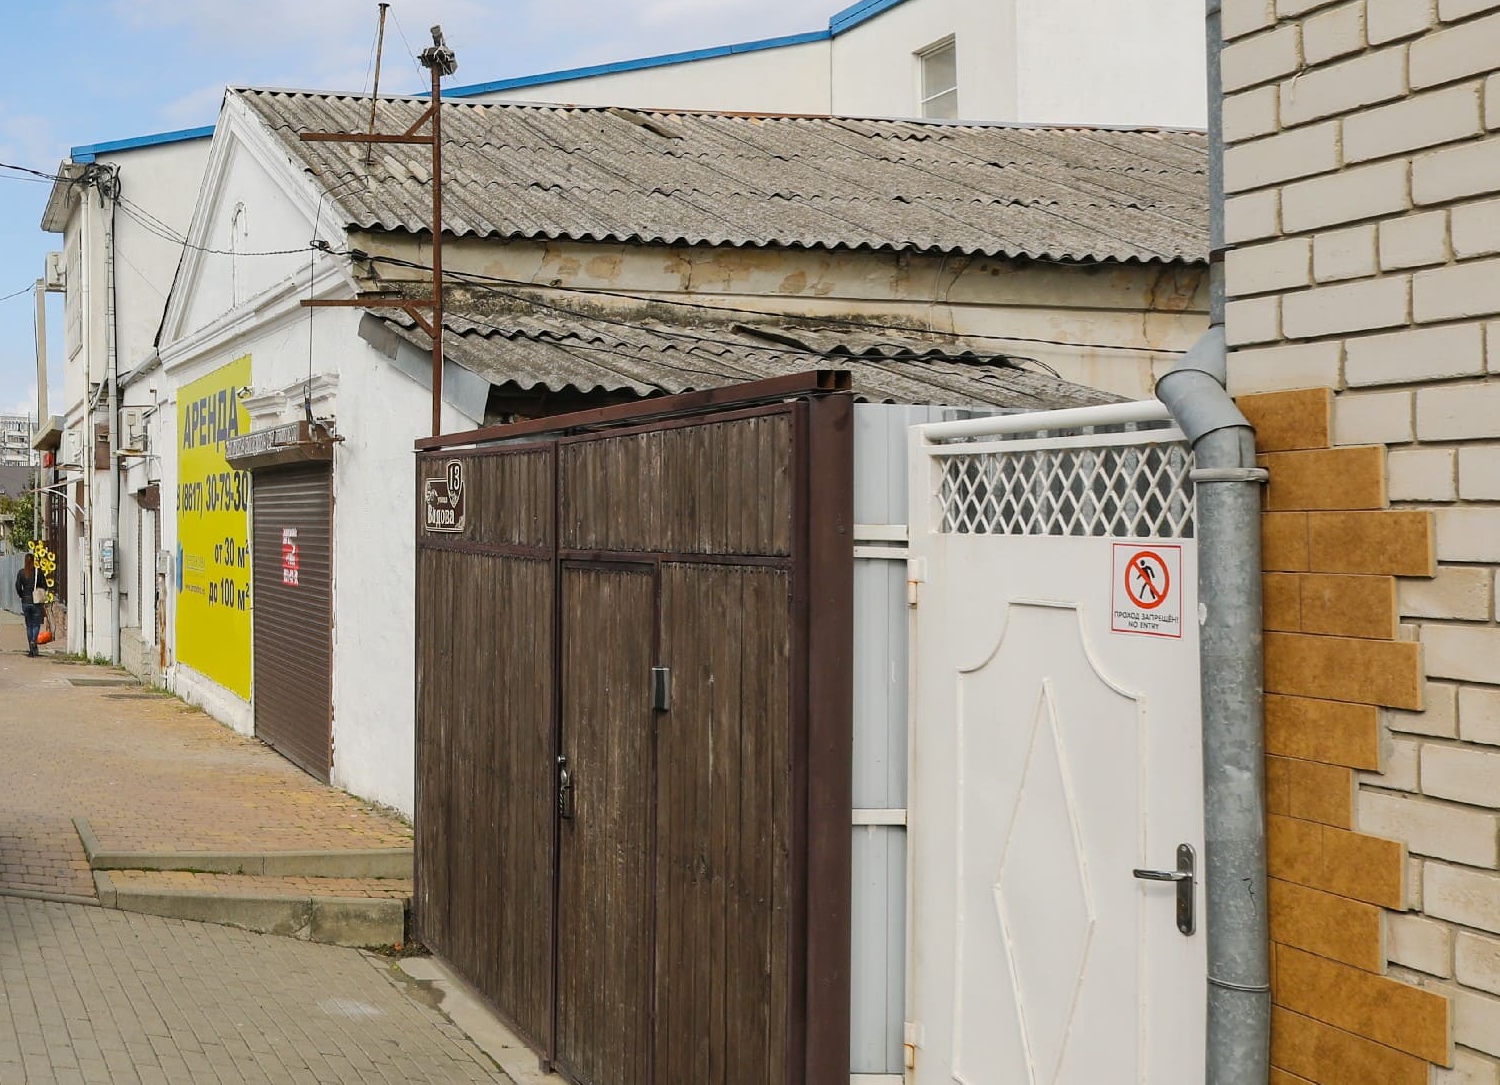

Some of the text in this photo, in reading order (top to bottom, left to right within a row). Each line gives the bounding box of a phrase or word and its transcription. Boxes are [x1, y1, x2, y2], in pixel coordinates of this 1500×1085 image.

[183, 386, 238, 453] АРЕНДА
[450, 465, 460, 491] 13
[182, 482, 203, 518] (8617)
[206, 471, 248, 512] 30-79-30
[427, 504, 455, 529] Видова
[214, 544, 223, 564] от
[225, 537, 235, 567] 30
[209, 582, 218, 607] до
[220, 577, 235, 608] 100
[1114, 611, 1140, 621] ПРОХОД
[1128, 620, 1159, 629] NO ENTRY
